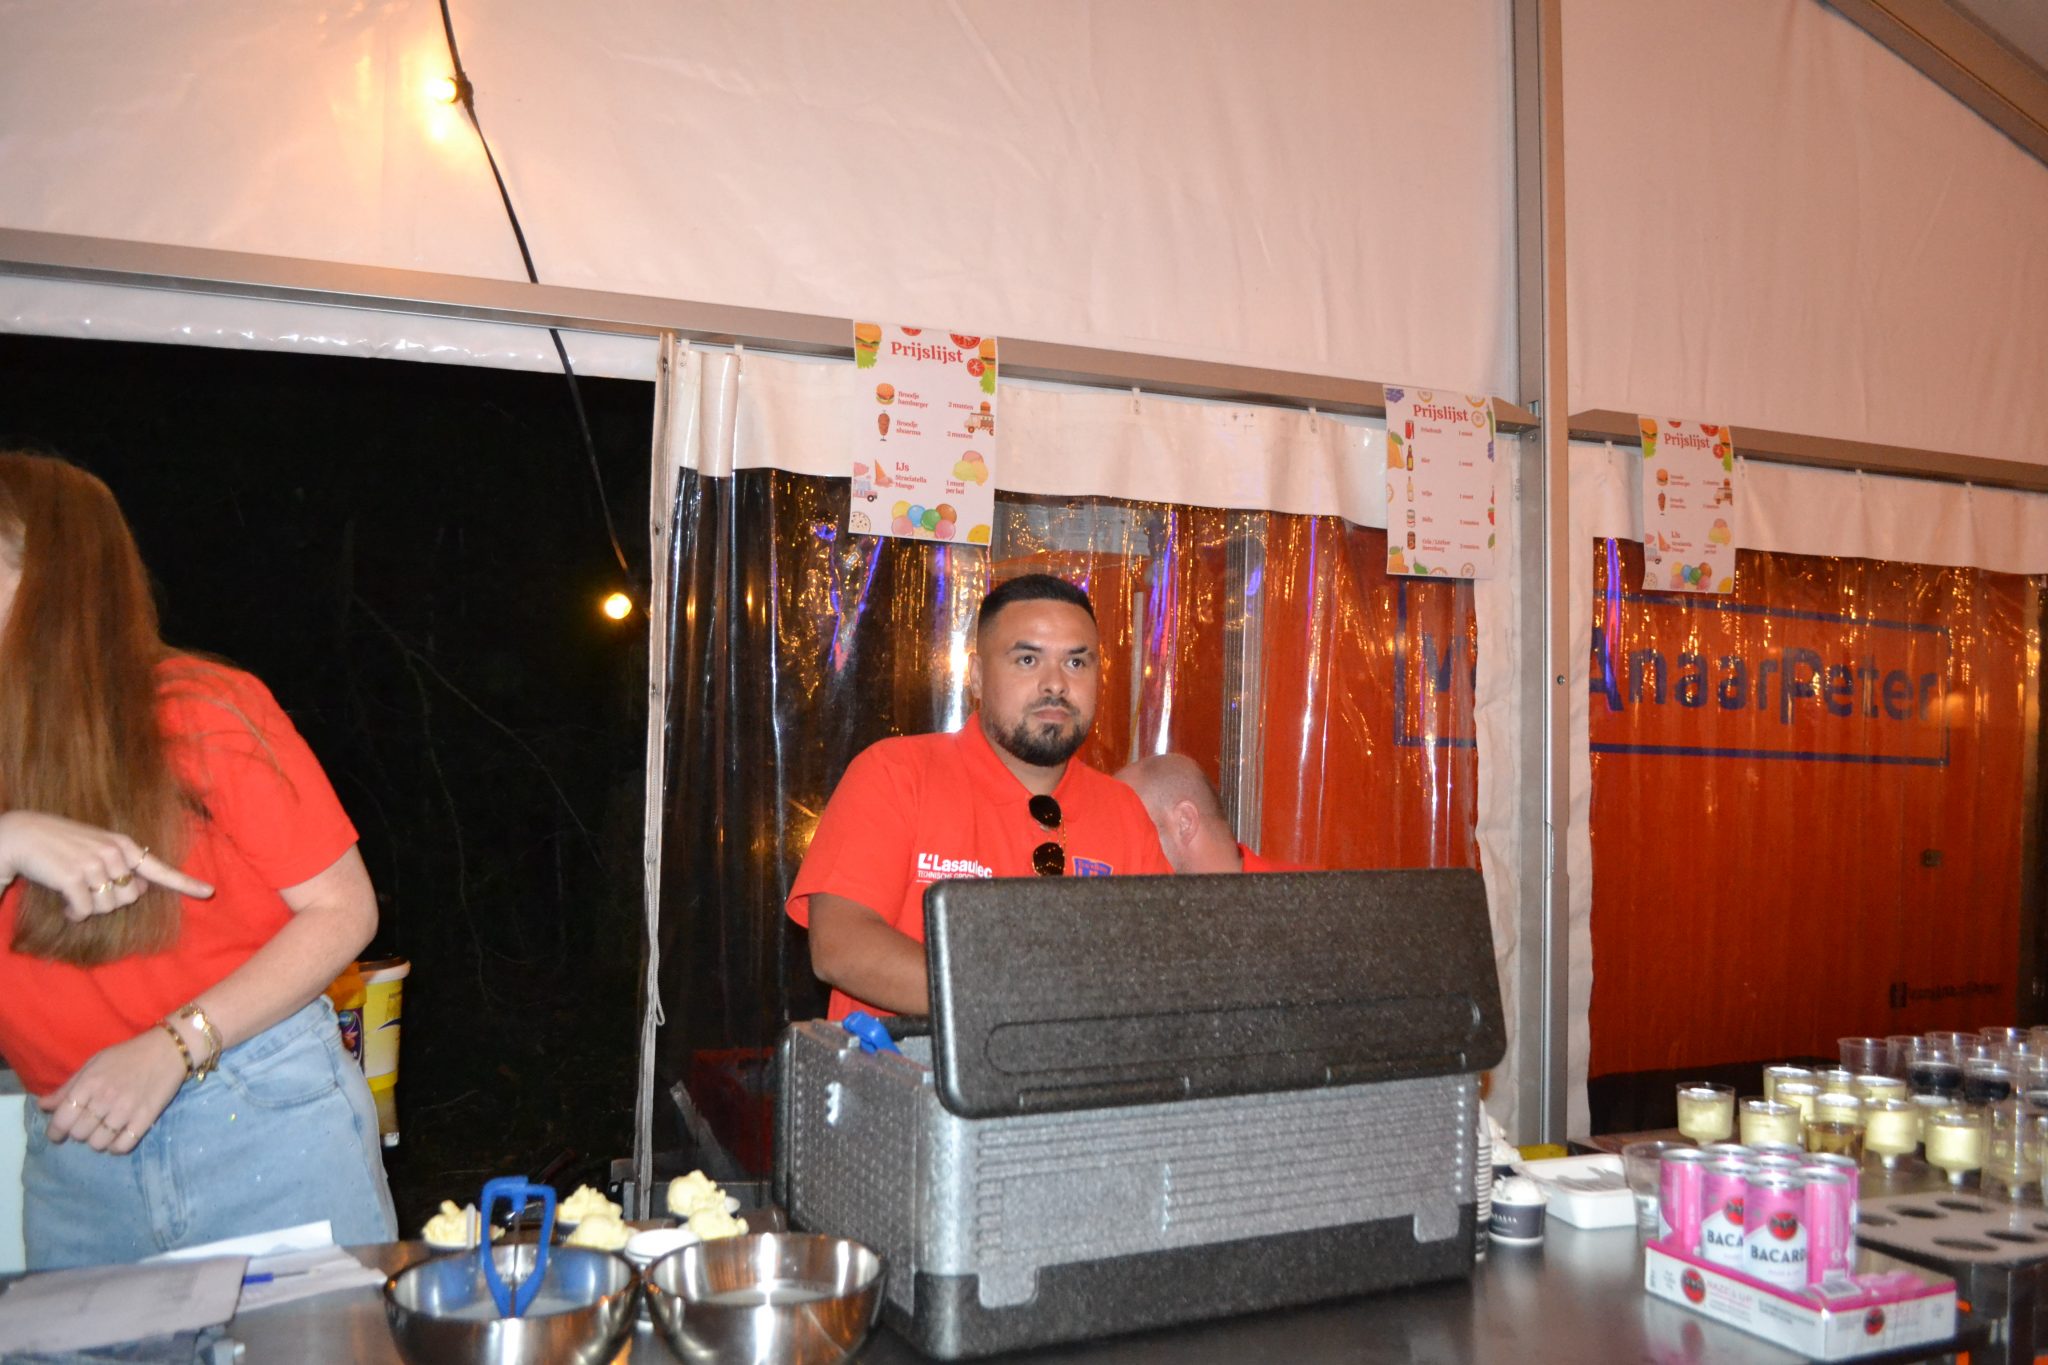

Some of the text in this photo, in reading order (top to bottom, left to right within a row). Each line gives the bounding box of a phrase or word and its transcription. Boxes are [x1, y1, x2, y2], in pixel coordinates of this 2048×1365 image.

[891, 341, 964, 364] Prijslijst
[897, 399, 928, 409] hamburger
[1413, 404, 1469, 423] Prijslijst
[1664, 433, 1711, 450] Prijslijst
[895, 482, 915, 490] Mango
[932, 854, 993, 879] Lasaulec
[1706, 1228, 1744, 1247] BACA
[1750, 1244, 1807, 1263] BACARD
